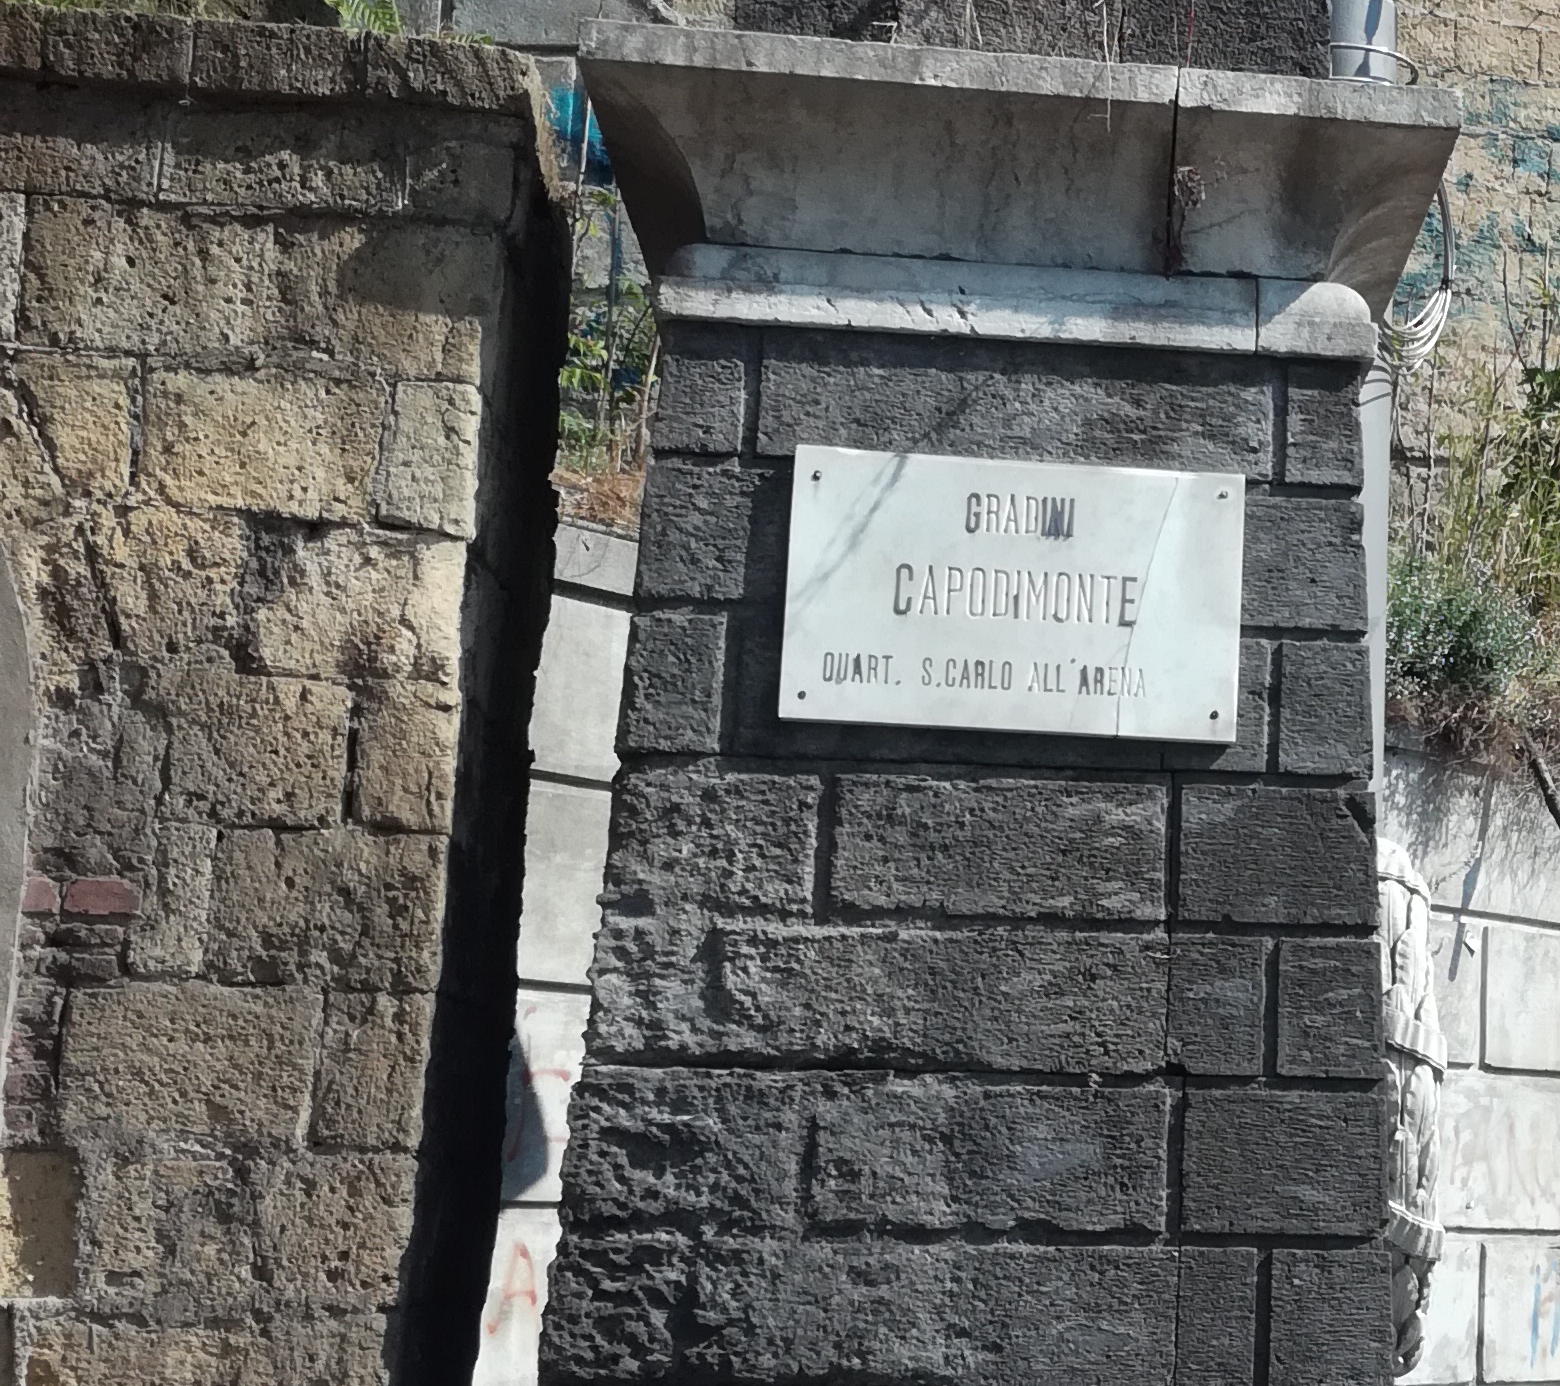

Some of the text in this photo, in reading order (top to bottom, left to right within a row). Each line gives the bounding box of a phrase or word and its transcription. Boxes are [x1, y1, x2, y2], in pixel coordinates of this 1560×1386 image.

[965, 491, 1077, 540] GRADINI
[892, 562, 1139, 628] CAPODIMONTE
[822, 651, 902, 686] QUART.
[920, 656, 1014, 692] S.CARLO
